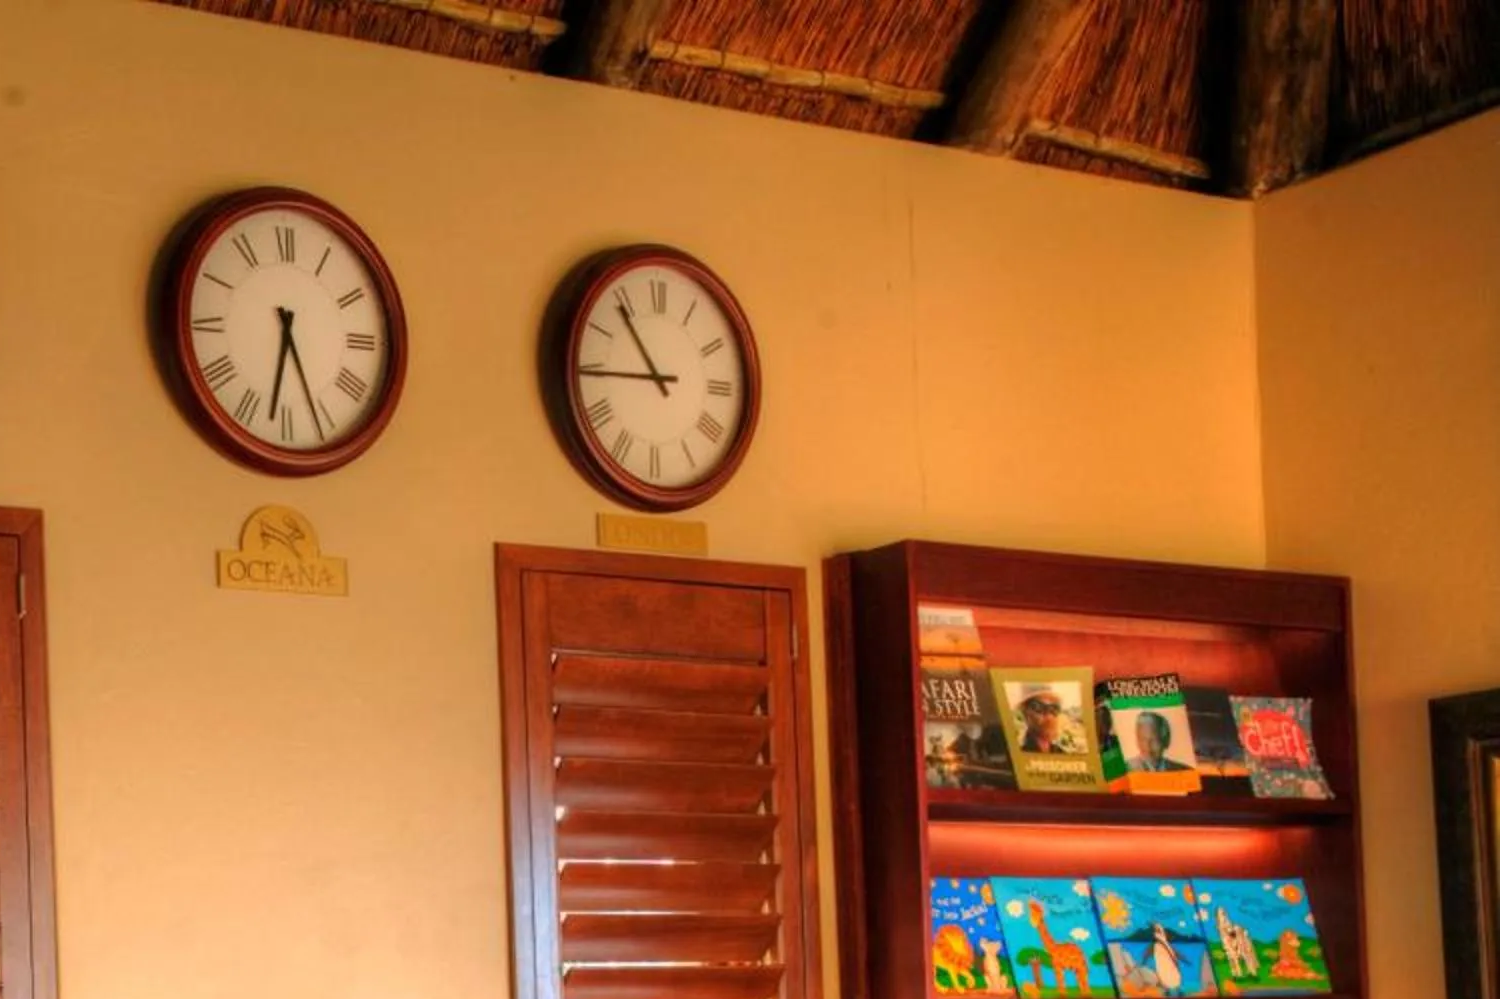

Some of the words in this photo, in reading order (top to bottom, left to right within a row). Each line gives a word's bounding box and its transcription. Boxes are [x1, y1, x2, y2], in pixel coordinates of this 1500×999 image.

[227, 558, 338, 588] OCEANA
[920, 678, 978, 700] AFARI
[934, 699, 980, 717] STYLE
